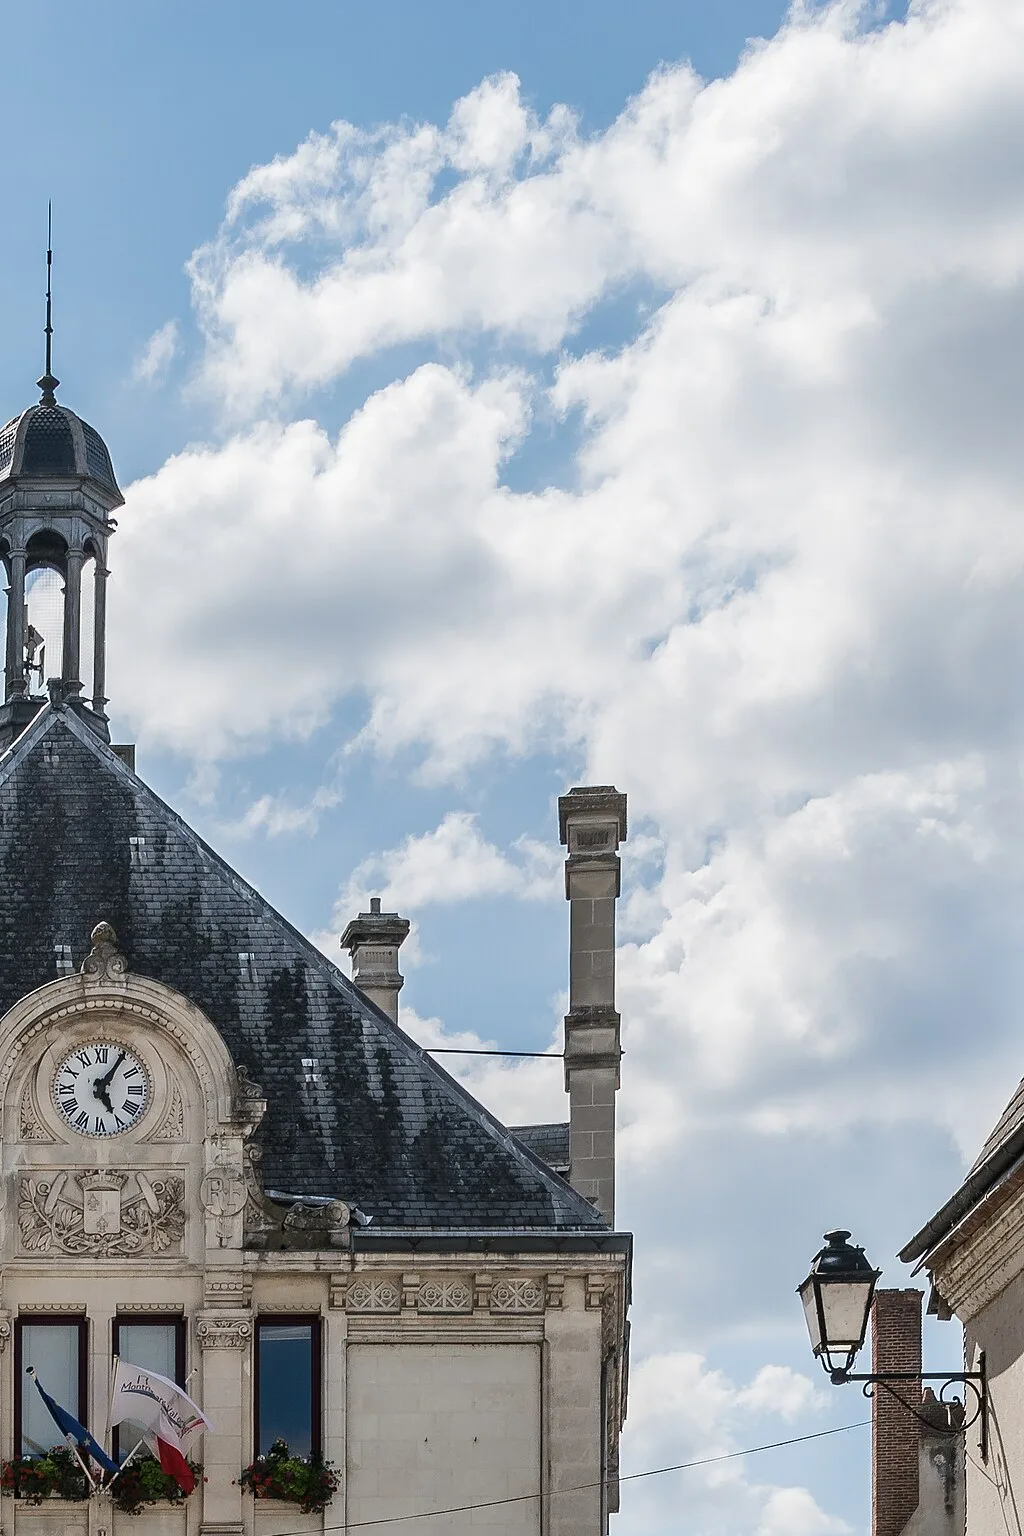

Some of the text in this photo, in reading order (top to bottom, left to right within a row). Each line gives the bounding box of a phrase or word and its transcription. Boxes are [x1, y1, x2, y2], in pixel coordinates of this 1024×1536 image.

[76, 1052, 92, 1069] XI
[95, 1048, 108, 1064] XII
[64, 1065, 80, 1079] X
[123, 1067, 139, 1079] II
[128, 1085, 143, 1096] III
[114, 1114, 125, 1128] V
